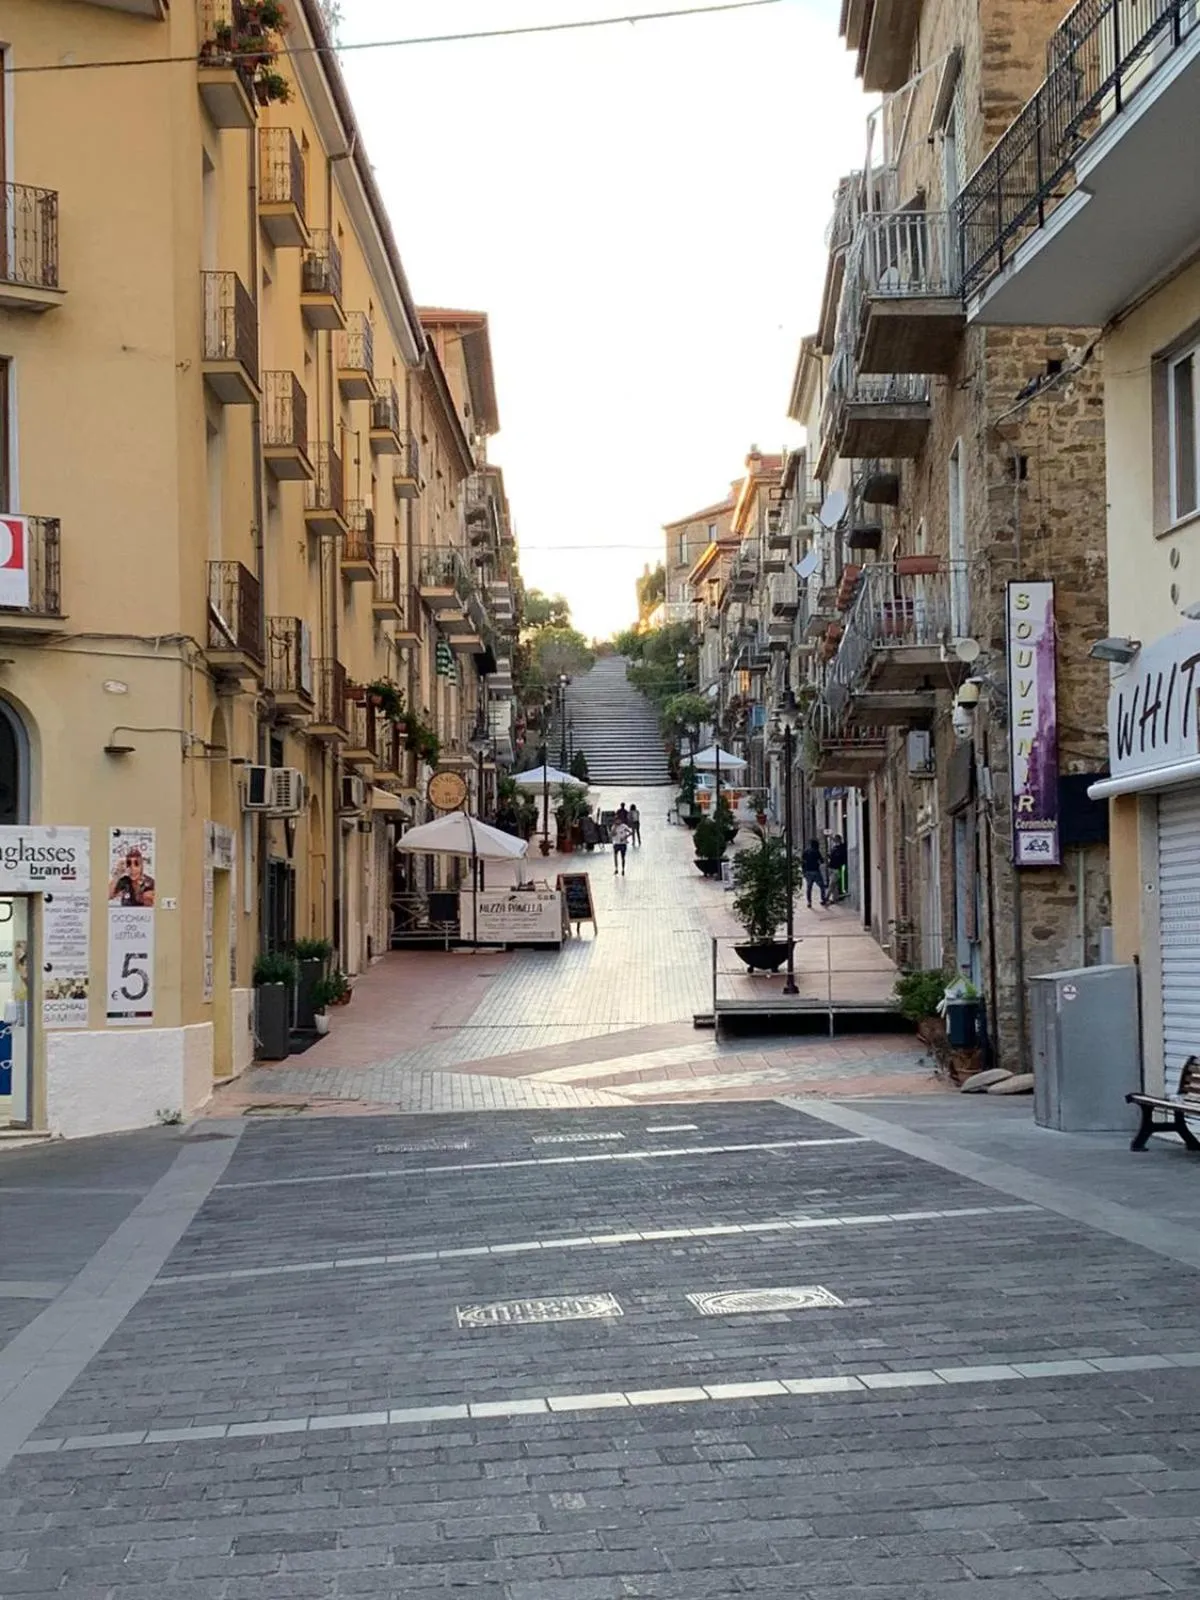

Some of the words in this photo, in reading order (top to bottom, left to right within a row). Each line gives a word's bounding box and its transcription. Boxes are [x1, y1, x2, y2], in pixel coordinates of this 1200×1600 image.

[1014, 592, 1036, 813] SOUVENIR
[1014, 818, 1058, 830] Ceramiche
[0, 837, 76, 870] glasses
[30, 864, 77, 875] brands
[111, 913, 152, 923] OCCHIALI
[120, 952, 150, 1001] 5
